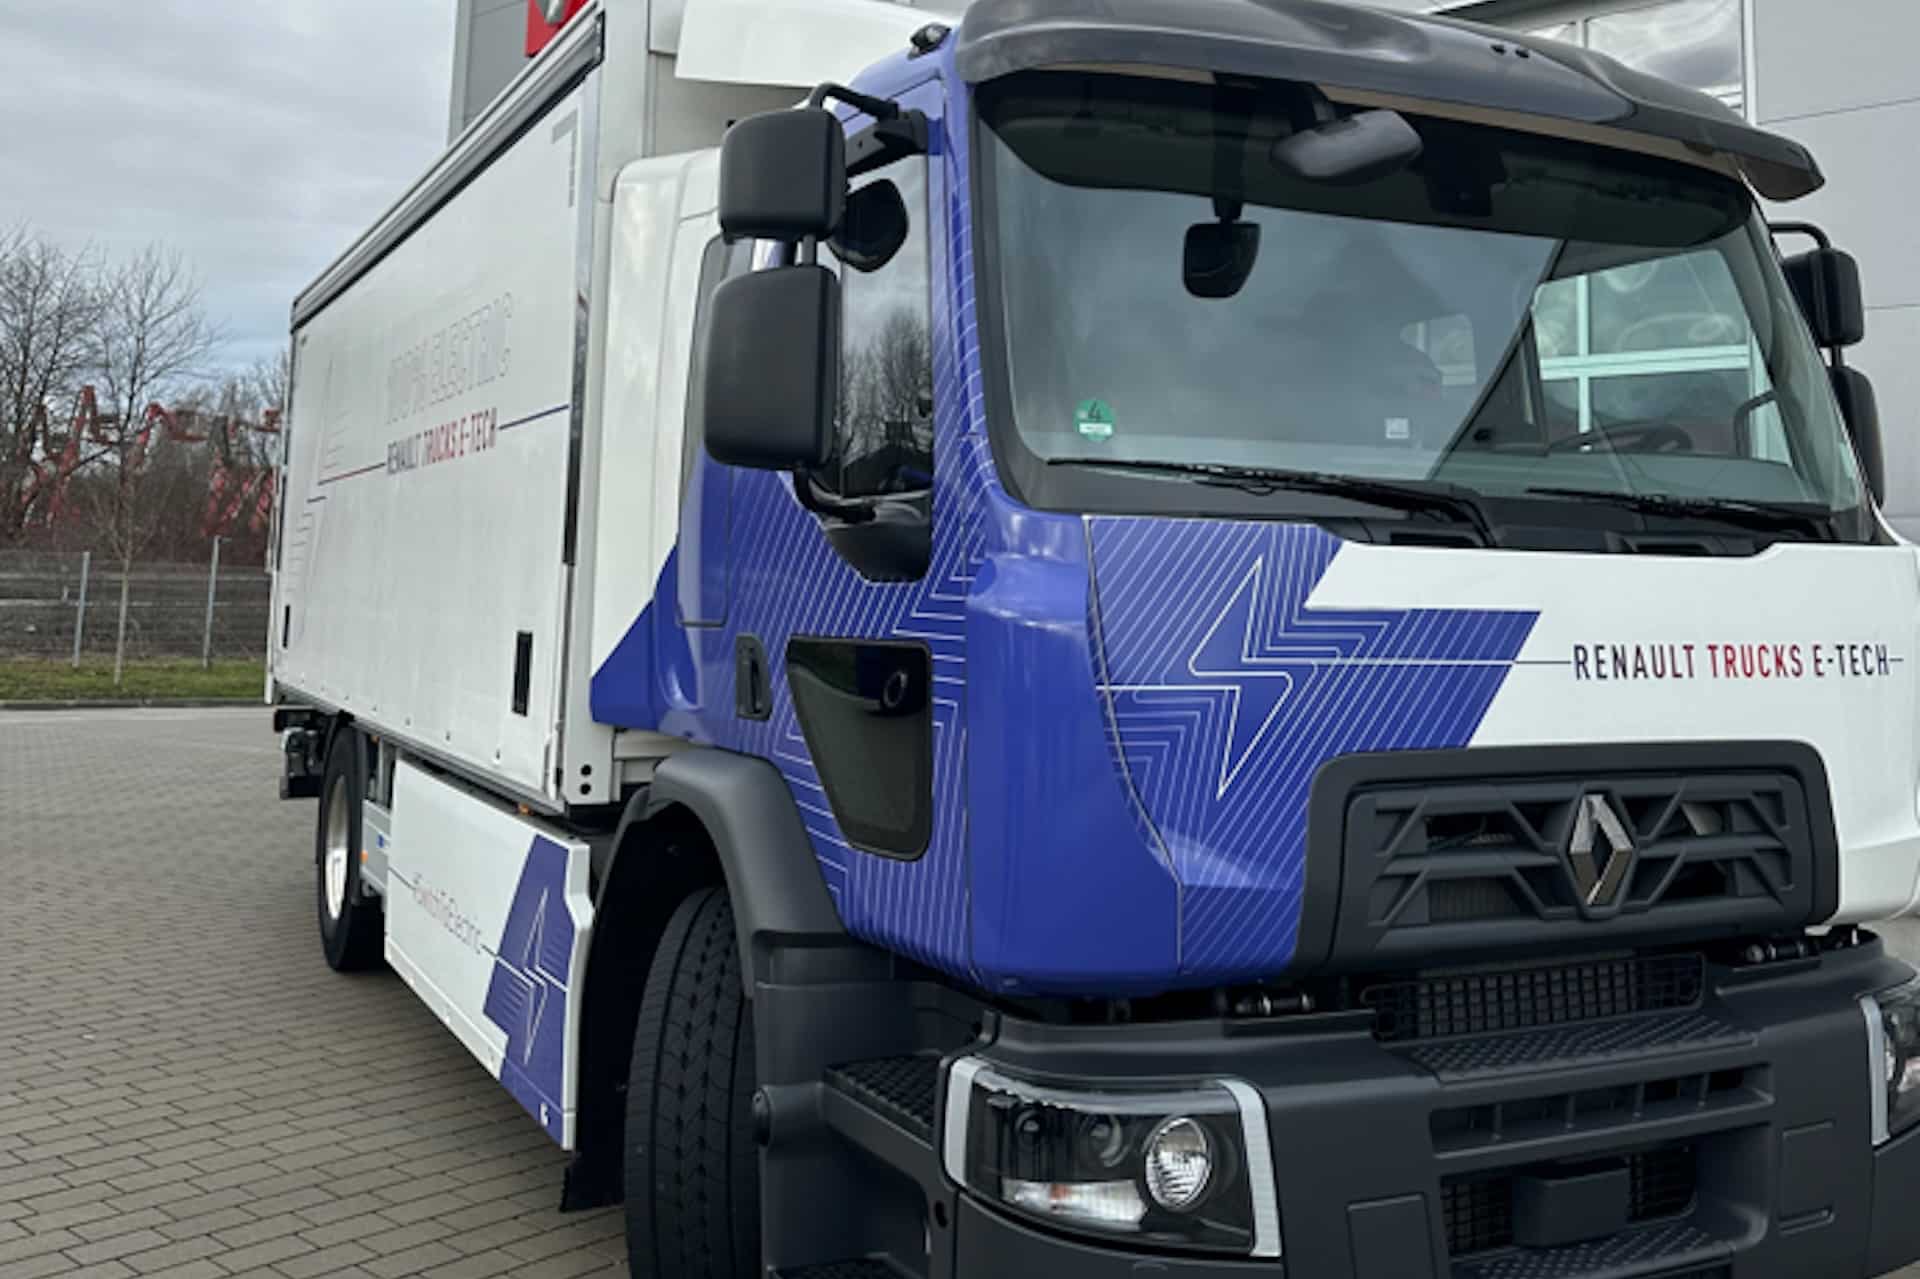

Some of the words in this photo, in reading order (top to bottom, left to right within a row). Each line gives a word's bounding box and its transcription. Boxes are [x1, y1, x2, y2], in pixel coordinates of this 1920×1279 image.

[1573, 643, 1695, 681] RENAULT
[1707, 643, 1802, 679] TRUCKS
[1813, 642, 1889, 678] E-TECH
